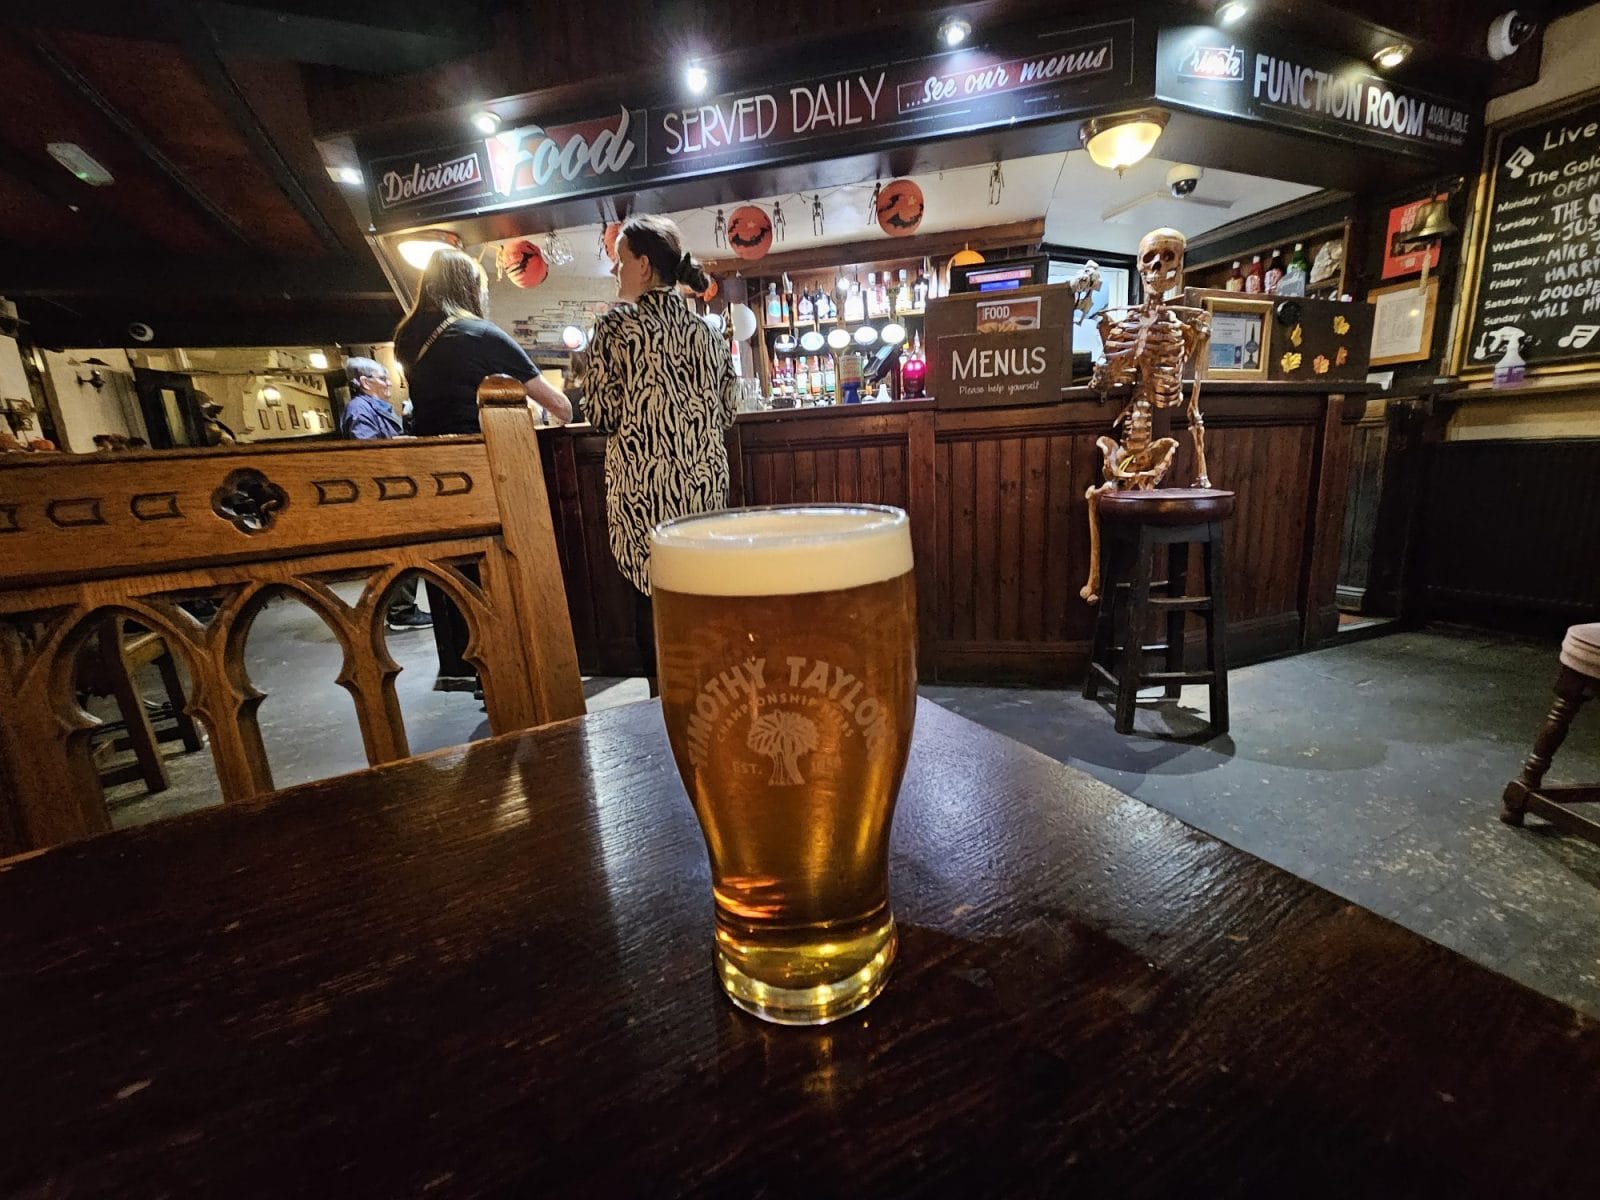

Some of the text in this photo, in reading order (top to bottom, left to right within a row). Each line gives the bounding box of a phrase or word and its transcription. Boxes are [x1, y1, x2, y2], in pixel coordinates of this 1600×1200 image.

[964, 65, 1009, 94] our
[1020, 47, 1107, 83] menus
[1178, 40, 1240, 77] Private
[1253, 54, 1426, 137] FUNCTION ROOM
[663, 71, 886, 155] SERVED DAILY
[496, 104, 635, 197] Food
[1543, 122, 1599, 151] Live
[383, 158, 475, 202] Delicious
[1528, 170, 1560, 187] The
[1551, 198, 1584, 224] THE
[1545, 242, 1588, 265] MIKE
[984, 305, 1010, 320] FOOD
[952, 346, 1047, 380] MENUS
[959, 381, 1040, 396] Please help yourself
